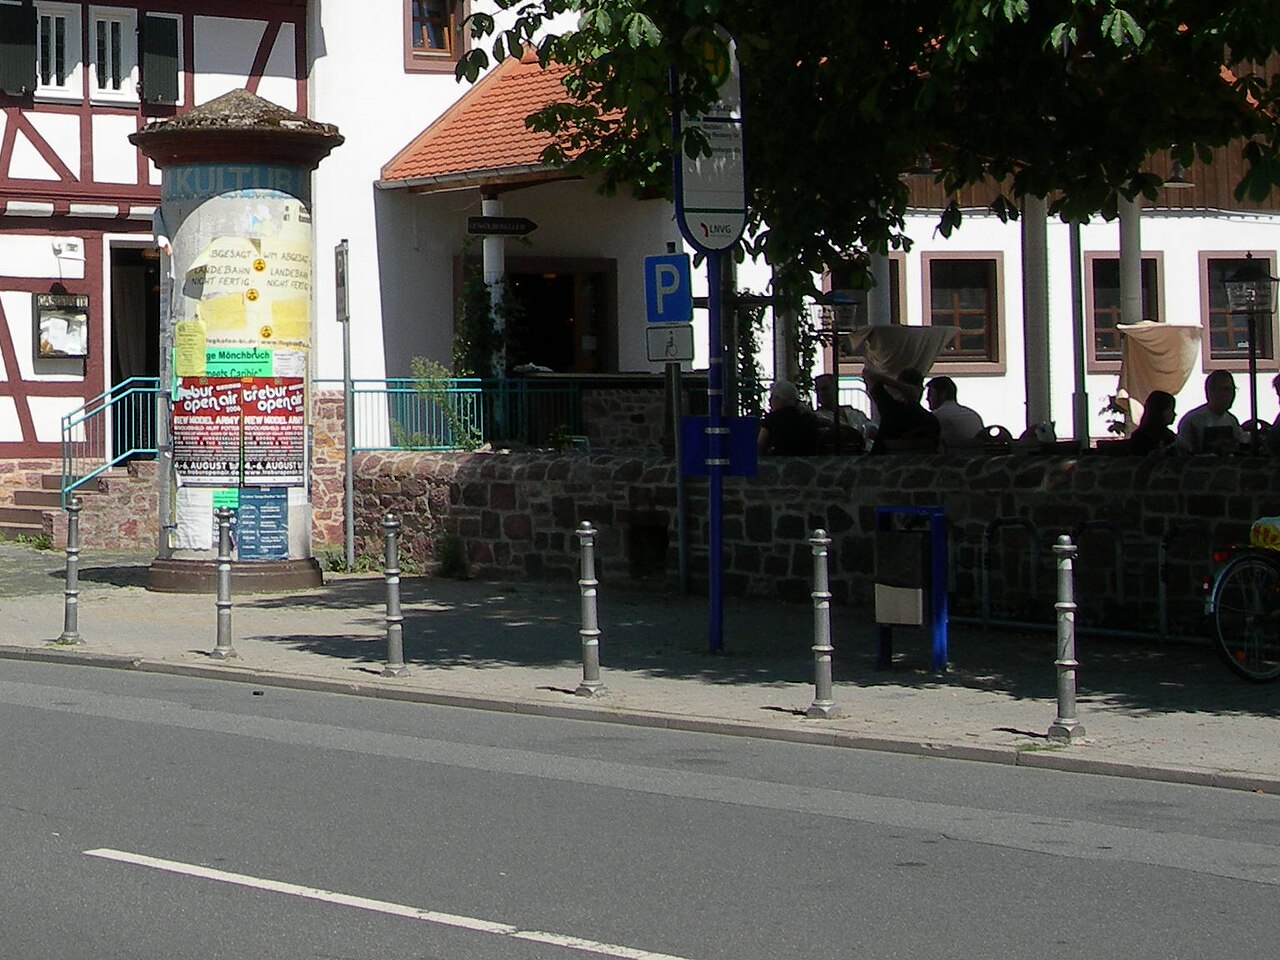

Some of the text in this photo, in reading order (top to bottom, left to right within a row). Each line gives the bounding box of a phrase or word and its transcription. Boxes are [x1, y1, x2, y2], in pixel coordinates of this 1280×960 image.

[709, 226, 732, 234] LNVG
[209, 249, 251, 259] BGESAGT
[655, 264, 681, 315] P
[219, 350, 269, 359] Mönchbruch
[184, 391, 238, 413] open air
[257, 396, 292, 413] open
[191, 461, 227, 469] AUGUST
[266, 461, 296, 470] AUGUST
